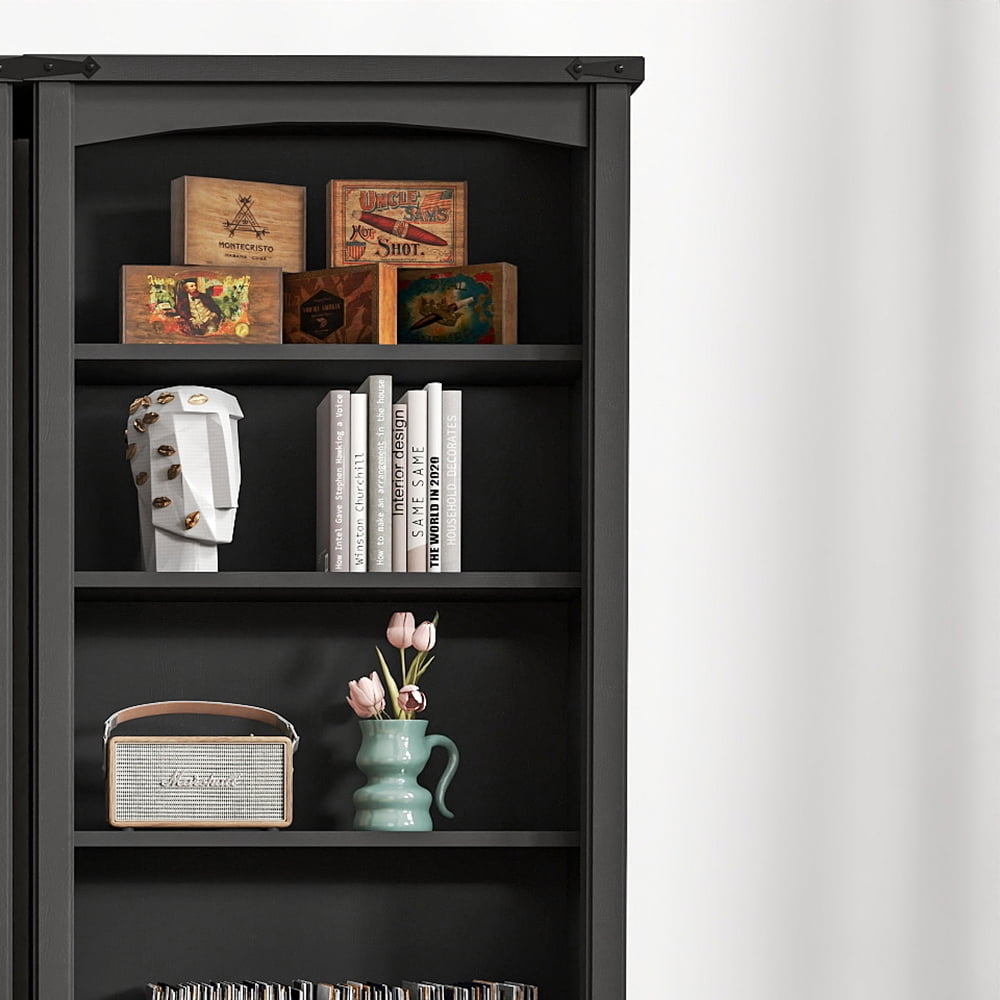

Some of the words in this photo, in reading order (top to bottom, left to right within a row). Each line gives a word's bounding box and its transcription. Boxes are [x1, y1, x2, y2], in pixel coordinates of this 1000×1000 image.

[359, 190, 420, 211] UNCLE
[219, 241, 274, 252] MONTECRISTO
[376, 379, 385, 404] house
[335, 394, 343, 418] Voice
[376, 407, 384, 423] the
[376, 426, 384, 439] in
[392, 409, 408, 460] design
[335, 429, 345, 466] Hawking
[447, 415, 457, 477] DECORATES
[411, 446, 424, 487] SAME
[429, 456, 439, 487] 2020
[335, 467, 344, 500] Stephen
[354, 452, 365, 513] Churchill
[392, 464, 404, 516] Interior
[378, 497, 384, 509] an
[429, 489, 439, 501] IN
[335, 504, 343, 525] Gave
[376, 511, 384, 533] make
[411, 497, 424, 537] SAME
[429, 504, 439, 546] WORLD
[447, 483, 457, 546] HOUSEHOLD
[335, 528, 343, 551] Intel
[354, 519, 365, 567] Winston
[376, 538, 384, 548] to
[335, 558, 343, 570] How
[376, 553, 385, 566] How
[429, 548, 439, 569] THE
[160, 769, 241, 788] Marshall
